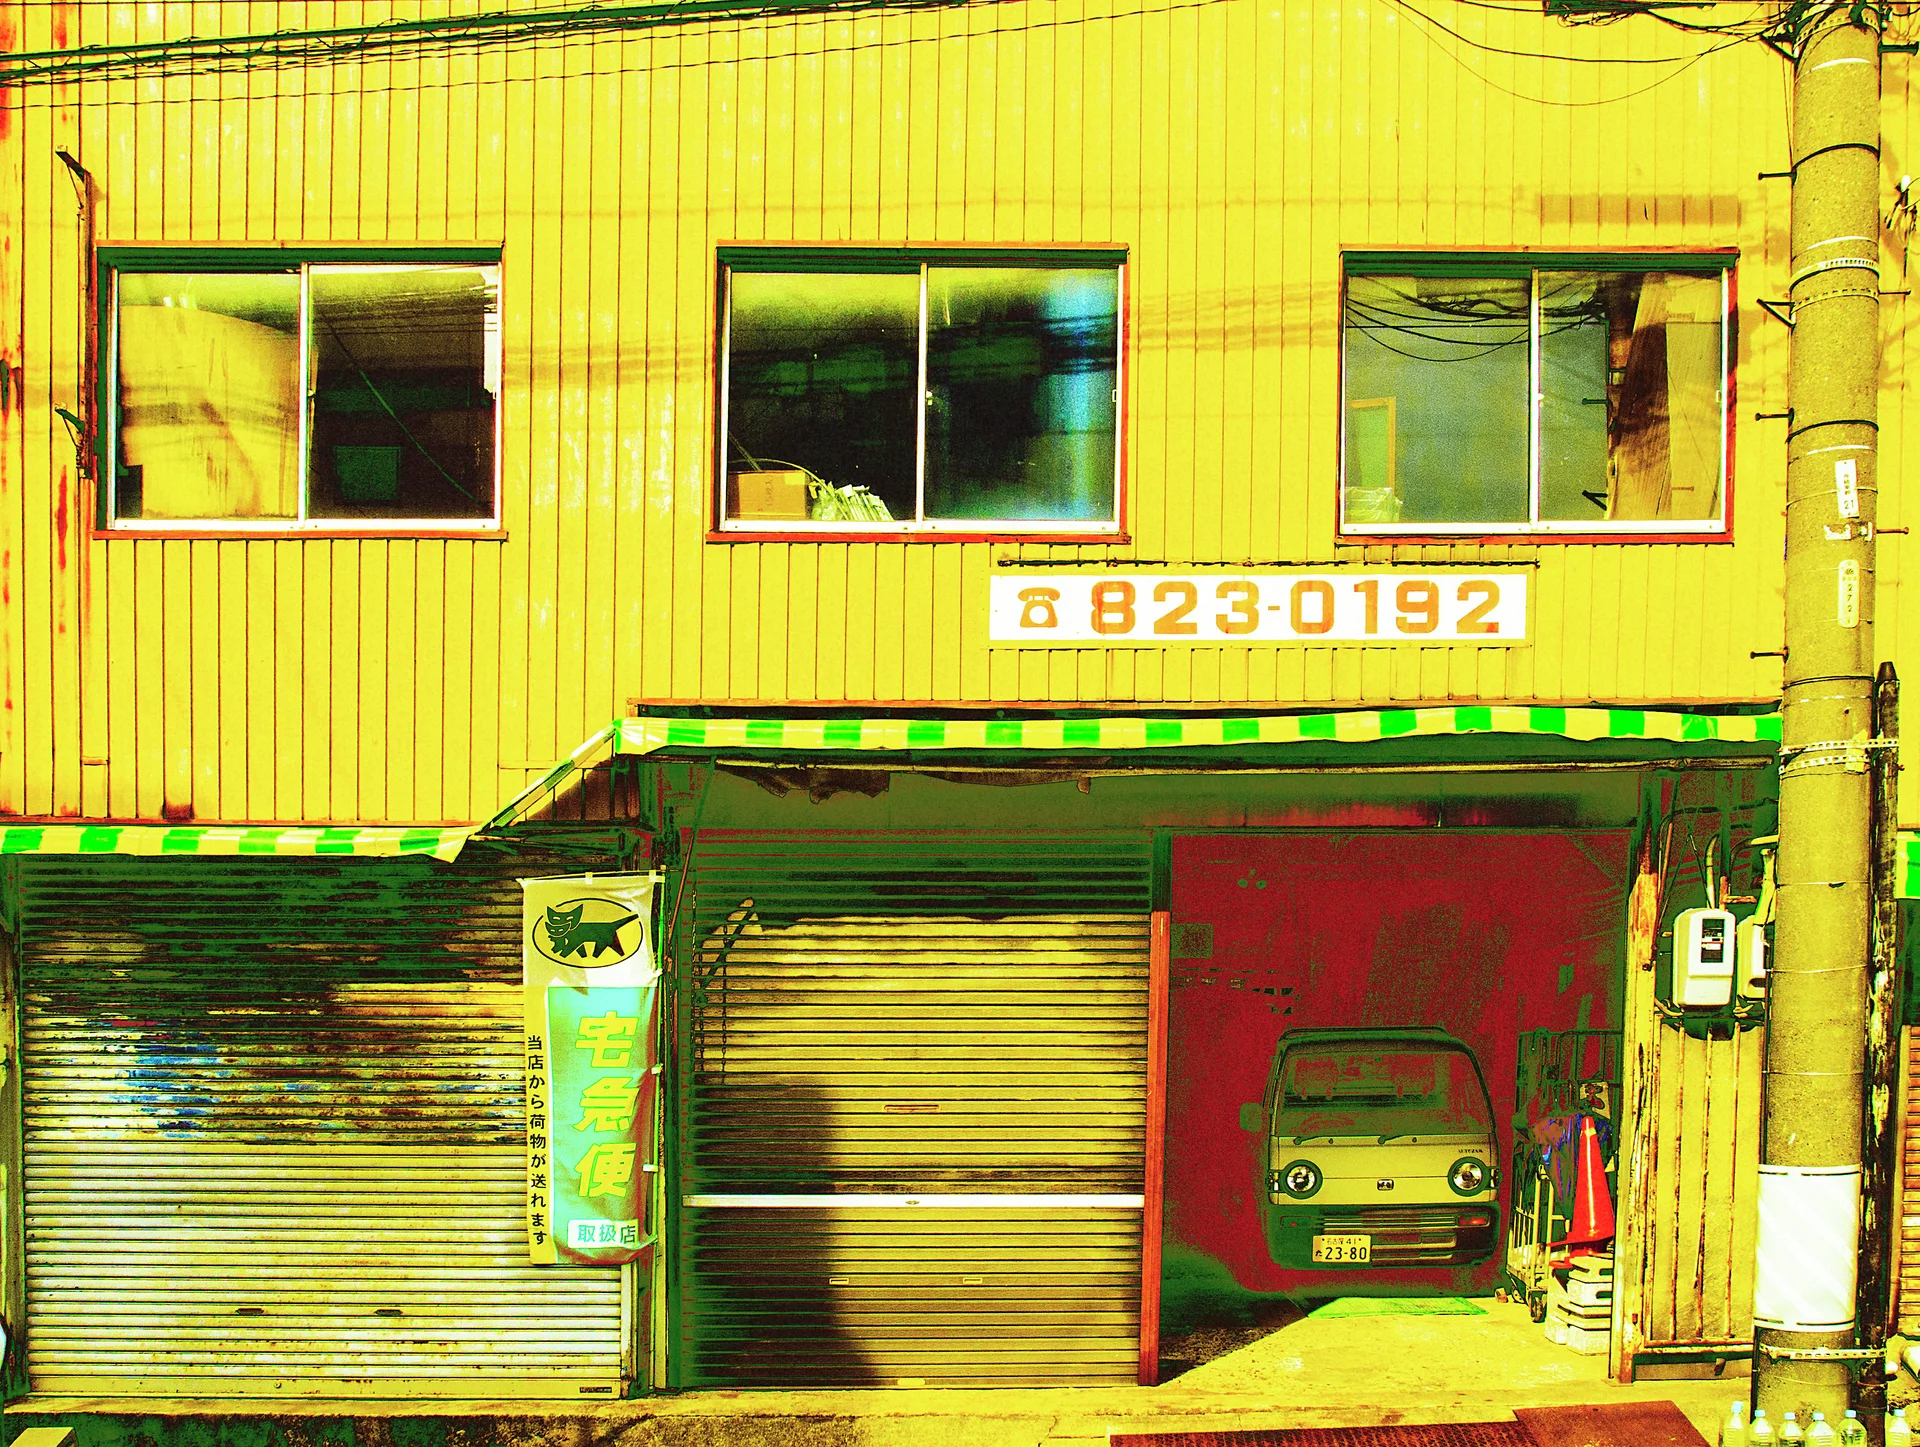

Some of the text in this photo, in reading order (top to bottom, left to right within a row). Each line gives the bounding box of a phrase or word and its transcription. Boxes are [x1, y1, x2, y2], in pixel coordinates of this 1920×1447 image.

[1090, 580, 1500, 634] 823-0192
[574, 1010, 639, 1199] 宅急便
[526, 1034, 548, 1246] 当店から荷物が送れます
[577, 1223, 636, 1245] 取扱店
[1325, 1246, 1367, 1260] 23-80
